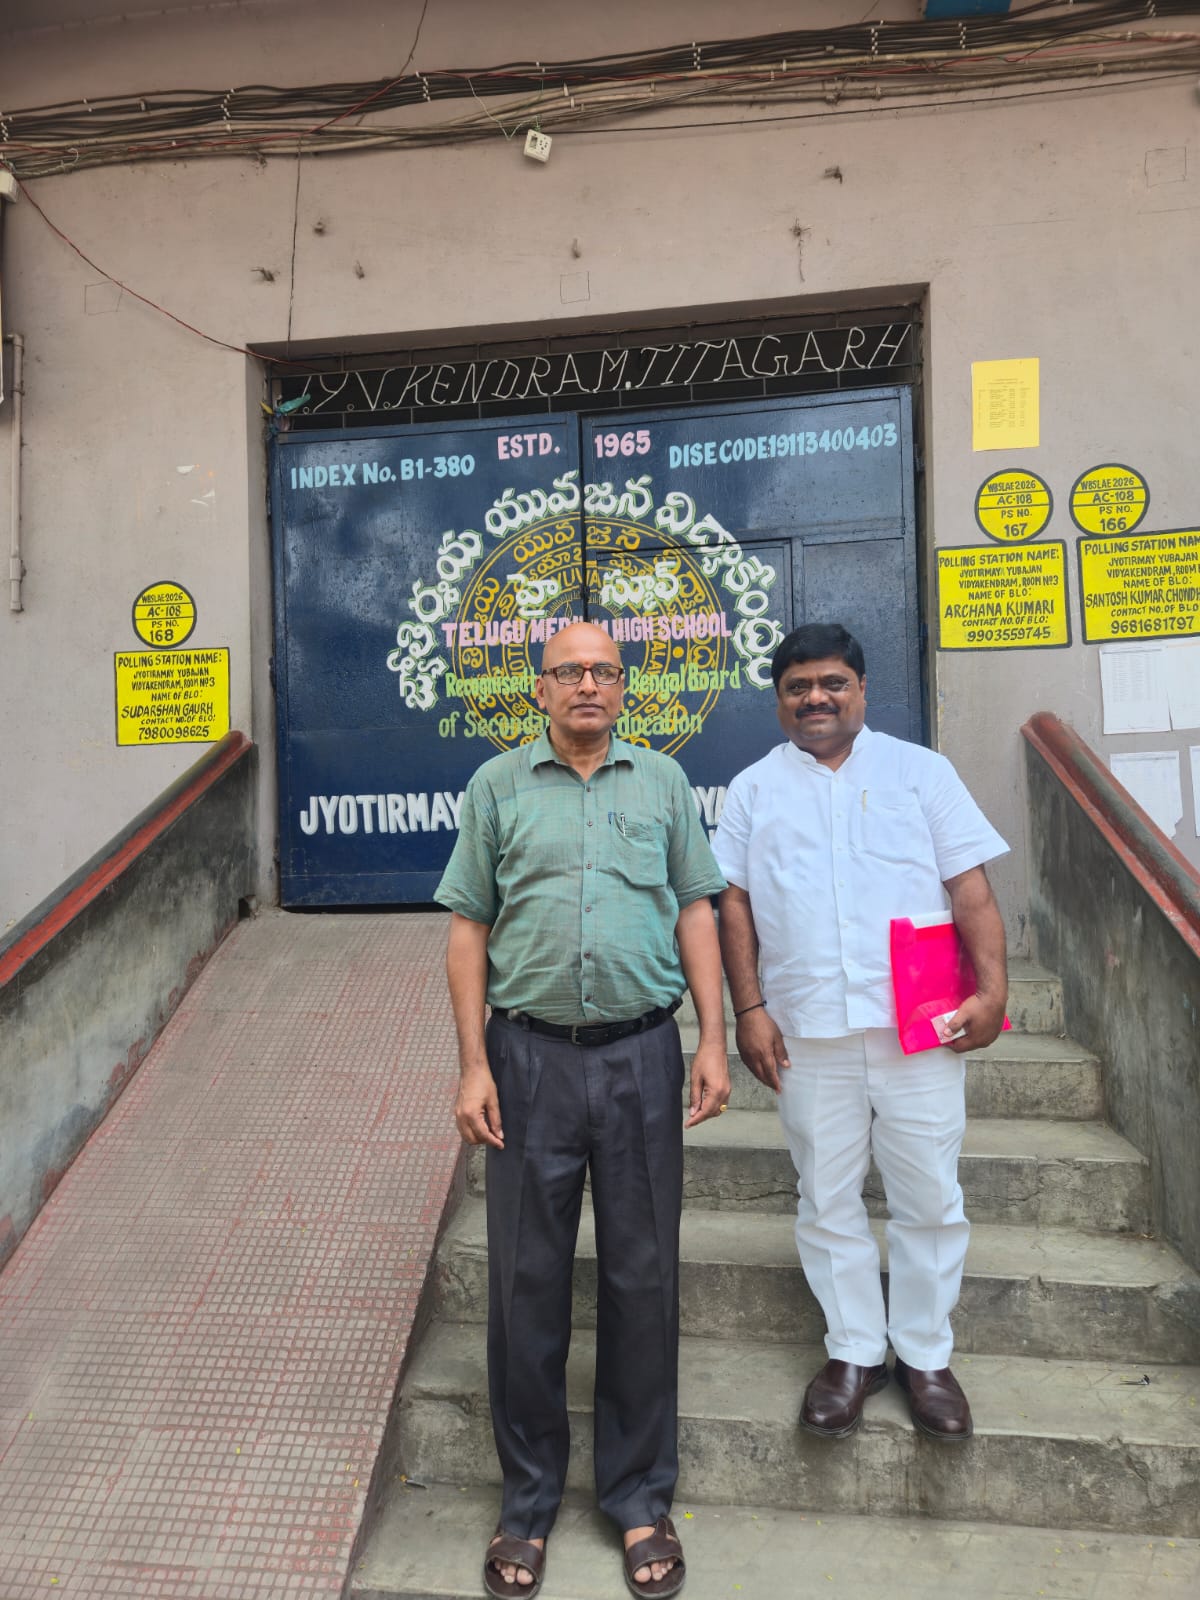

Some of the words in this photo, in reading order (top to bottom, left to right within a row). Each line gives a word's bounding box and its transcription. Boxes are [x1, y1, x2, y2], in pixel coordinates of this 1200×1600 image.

[497, 432, 561, 460] ESTD.
[594, 429, 651, 459] 1965
[669, 441, 718, 469] DISE
[291, 462, 356, 489] INDEX
[362, 461, 397, 485] No.
[400, 454, 475, 481] B1-380
[1081, 479, 1111, 491] WBSLAE
[1112, 476, 1135, 488] 2026
[1092, 490, 1135, 504] AC-108
[1001, 509, 1013, 519] PS
[1016, 508, 1033, 518] NO.
[1099, 505, 1113, 515] PS
[1116, 505, 1133, 514] NO.
[1004, 522, 1028, 537] 167
[1099, 516, 1127, 532] 166
[1084, 541, 1129, 556] POLLING
[1131, 537, 1176, 552] STATION
[939, 555, 976, 568] POLLING
[979, 551, 1023, 565] STATION
[1026, 548, 1060, 561] NAME:
[1108, 554, 1156, 567] JYOTIRMAY
[1158, 551, 1199, 564] YUBAJAN
[1006, 564, 1043, 576] YUBAJAN
[1123, 578, 1151, 589] NAME
[1152, 576, 1166, 587] OF
[968, 591, 992, 601] NAME
[994, 589, 1005, 599] OF
[1085, 590, 1128, 608] SANTOSH
[1130, 588, 1166, 605] KUMAR
[944, 602, 1003, 619] ARCHANA
[1006, 599, 1054, 617] KUMARI
[1110, 606, 1146, 617] CONTACT
[151, 620, 163, 628] PS
[441, 620, 526, 648] TELUGU
[612, 617, 653, 642] HIGH
[658, 612, 732, 641] SCHOOL
[962, 617, 999, 627] CONTACT
[1110, 615, 1195, 635] 9681681797
[150, 628, 174, 642] 168
[967, 626, 1051, 643] 9903559745
[118, 655, 153, 668] POLLING
[155, 653, 192, 666] STATION
[193, 652, 222, 665] NAME:
[177, 666, 209, 678] YUBAJAN
[629, 663, 686, 701] Bengal
[688, 660, 741, 692] Board
[151, 692, 171, 701] NAME
[173, 692, 181, 701] OF
[121, 703, 180, 719] SUDARSHAN
[182, 702, 213, 717] GAURH
[141, 716, 174, 725] CONTACT
[438, 711, 460, 738] of
[464, 708, 551, 738] Secondar
